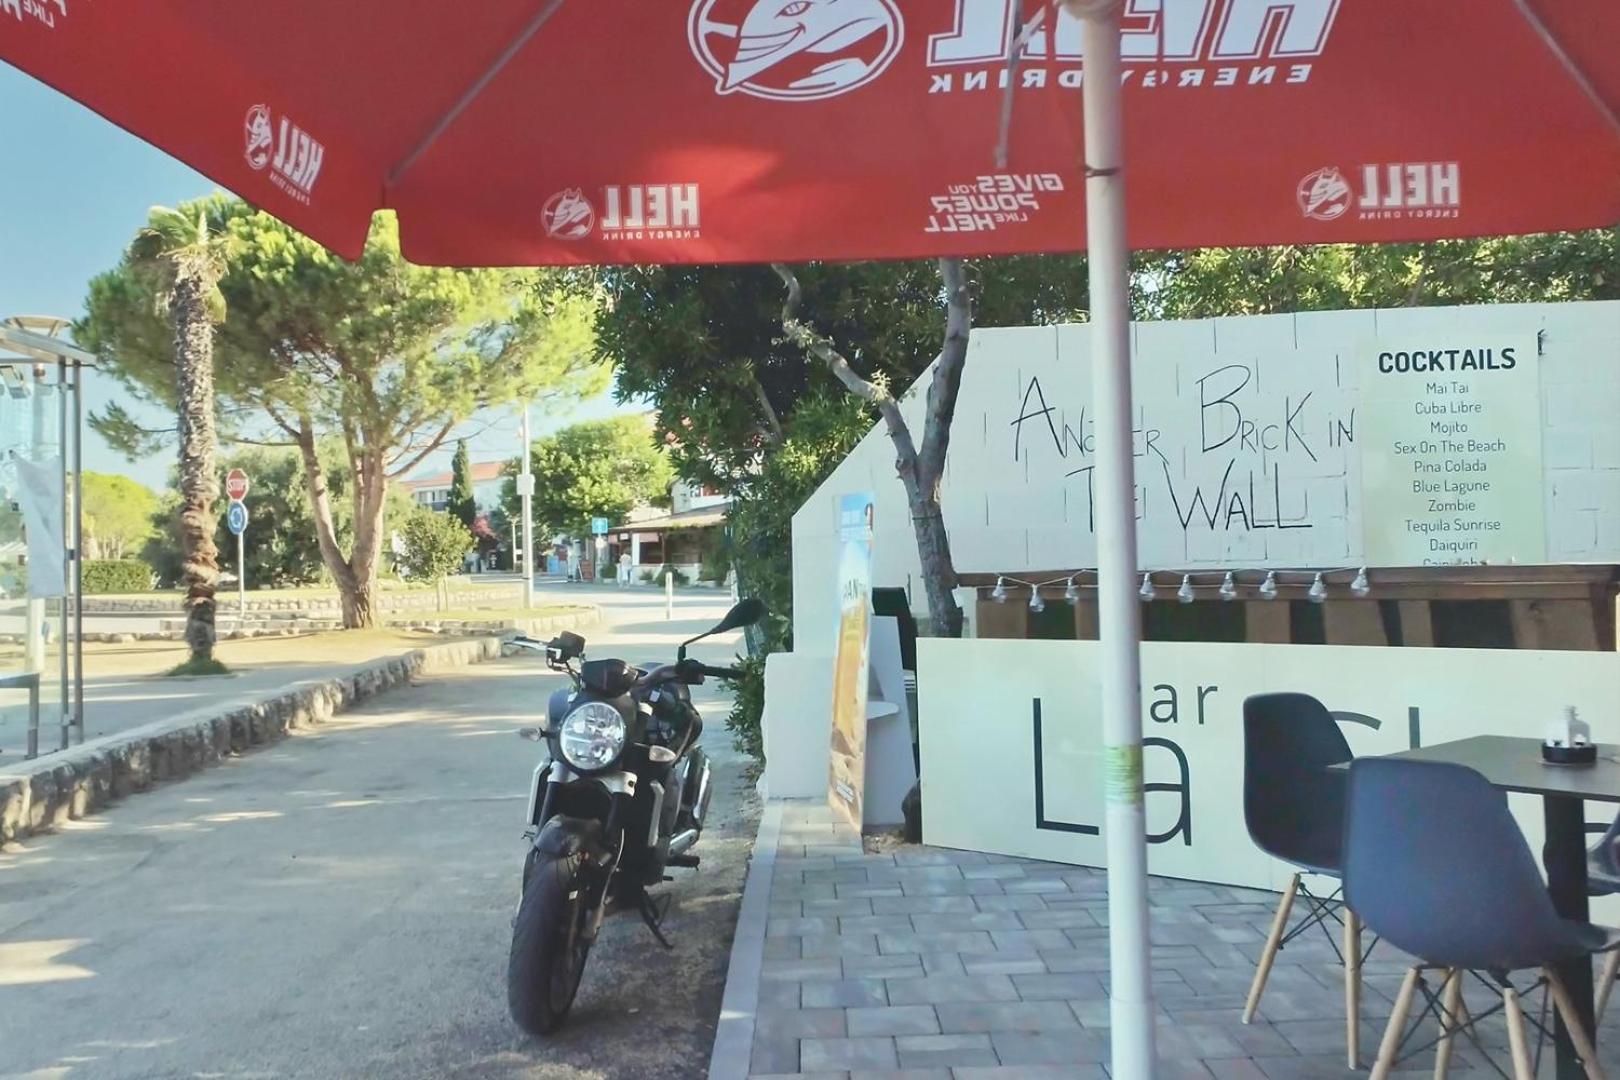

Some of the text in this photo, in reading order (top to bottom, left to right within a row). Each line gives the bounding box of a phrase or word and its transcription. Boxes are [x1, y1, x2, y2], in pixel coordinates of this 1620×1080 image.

[1378, 348, 1516, 373] COCKTAILS
[1426, 381, 1469, 394] Mai Tai
[1415, 400, 1482, 414] Cuba Libre
[1430, 421, 1468, 436] Mojito
[1394, 437, 1506, 454] Sex On The Beach
[1414, 459, 1487, 472] Pina Colada
[1163, 458, 1313, 530] WALL
[1413, 479, 1490, 495] Blue Lagune
[1428, 499, 1476, 512] Zombie
[1405, 518, 1501, 534] Tequila Sunrise
[1430, 538, 1478, 553] Daiquiri
[1148, 684, 1218, 725] ar
